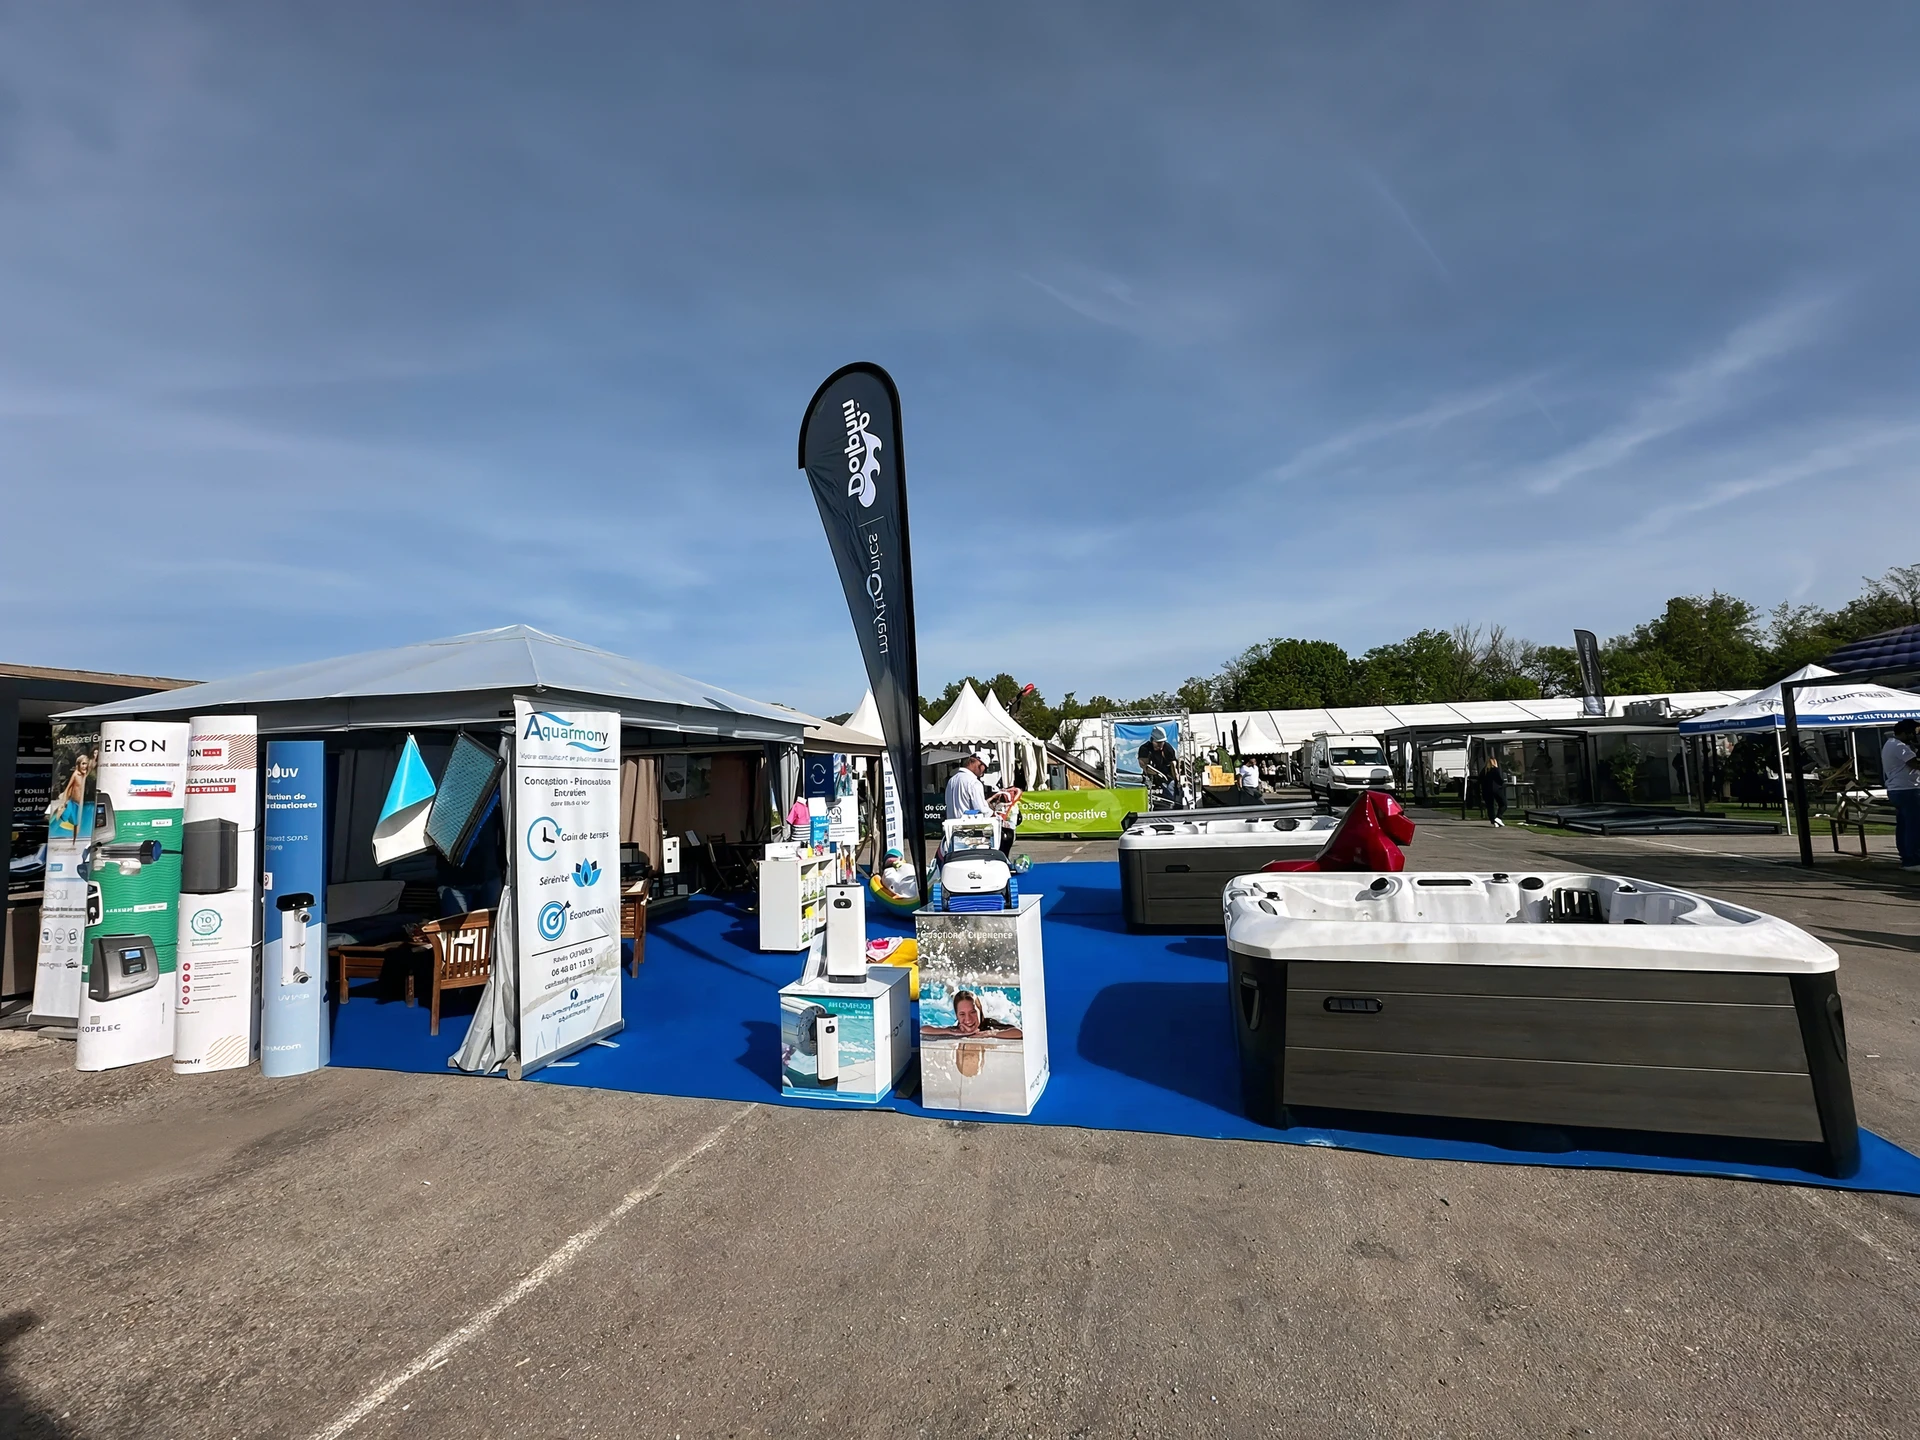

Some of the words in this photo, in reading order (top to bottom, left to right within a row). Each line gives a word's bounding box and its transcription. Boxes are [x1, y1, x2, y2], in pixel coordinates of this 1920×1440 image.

[523, 715, 608, 744] Aquarmony
[1063, 809, 1108, 822] positive
[578, 832, 588, 840] de
[551, 968, 560, 977] 06
